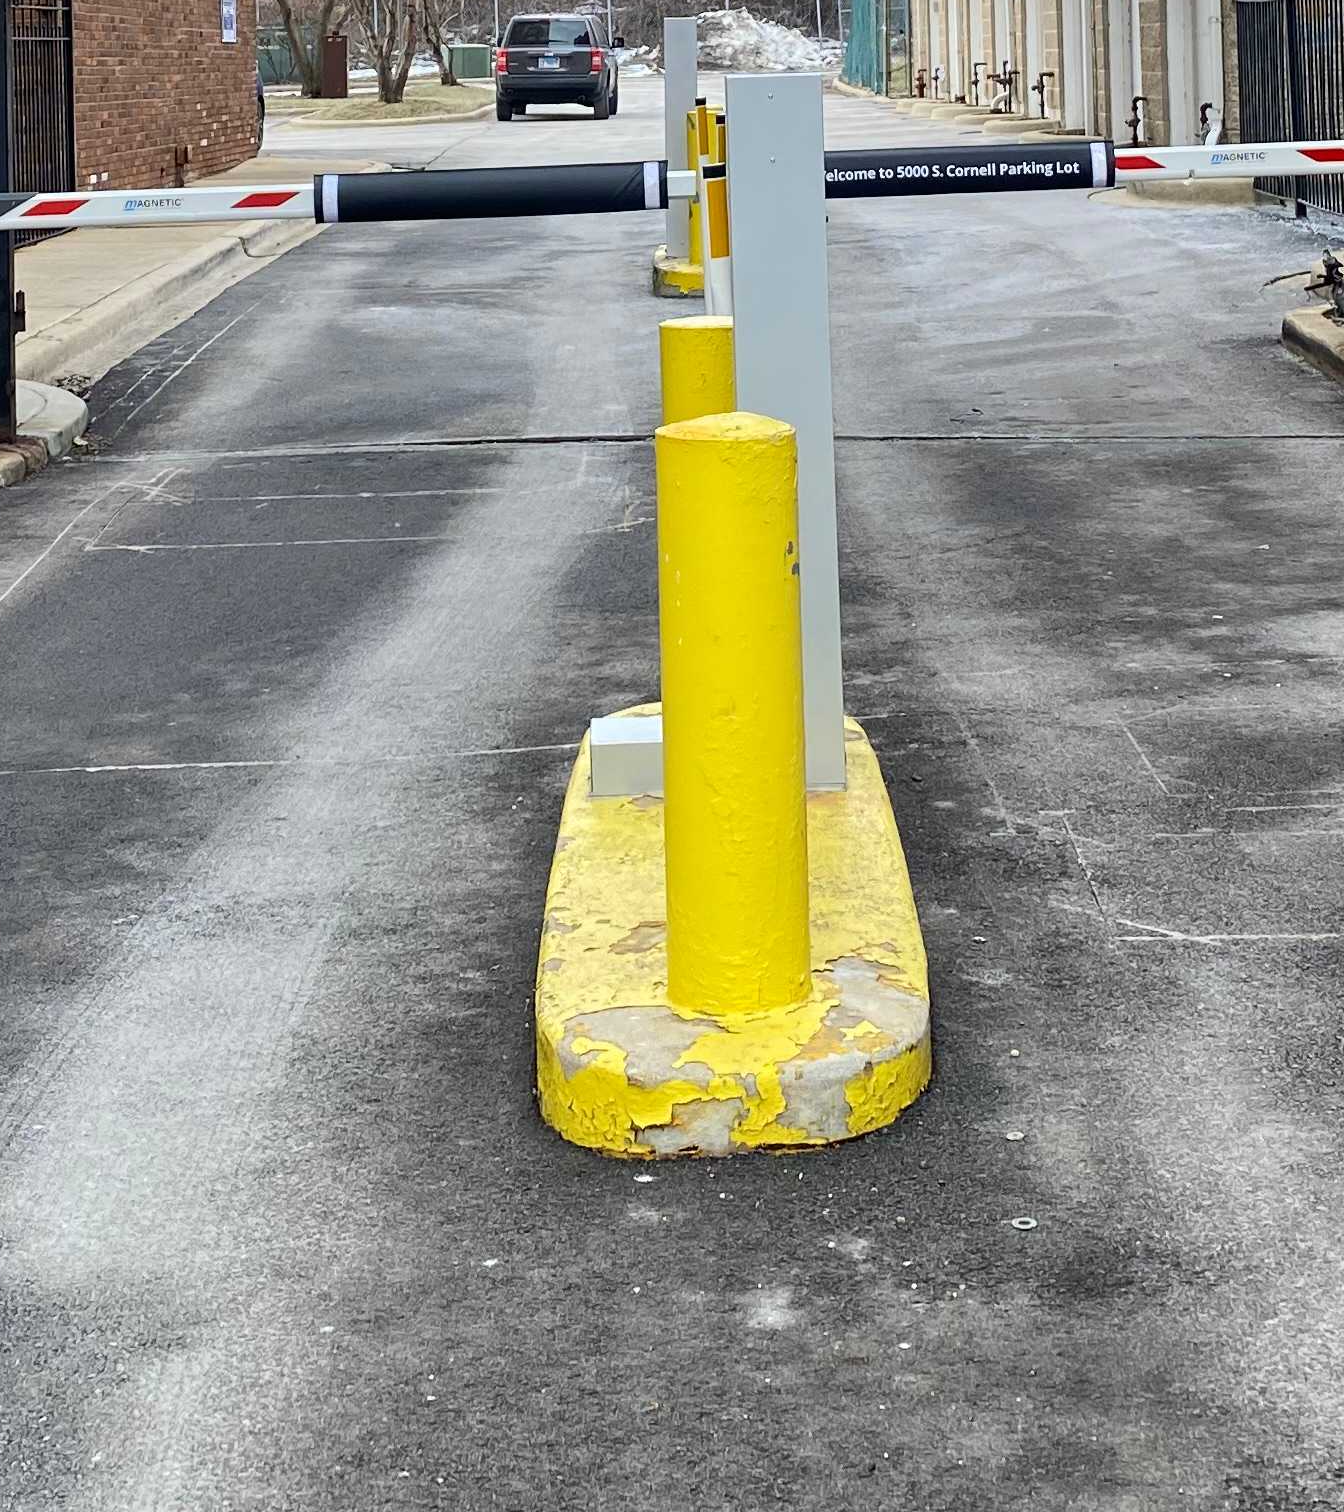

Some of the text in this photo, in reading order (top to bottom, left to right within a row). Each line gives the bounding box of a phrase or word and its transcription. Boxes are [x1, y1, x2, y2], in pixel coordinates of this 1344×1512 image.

[824, 161, 1080, 181] elcome to 5000 S. Cornell Parking Lot
